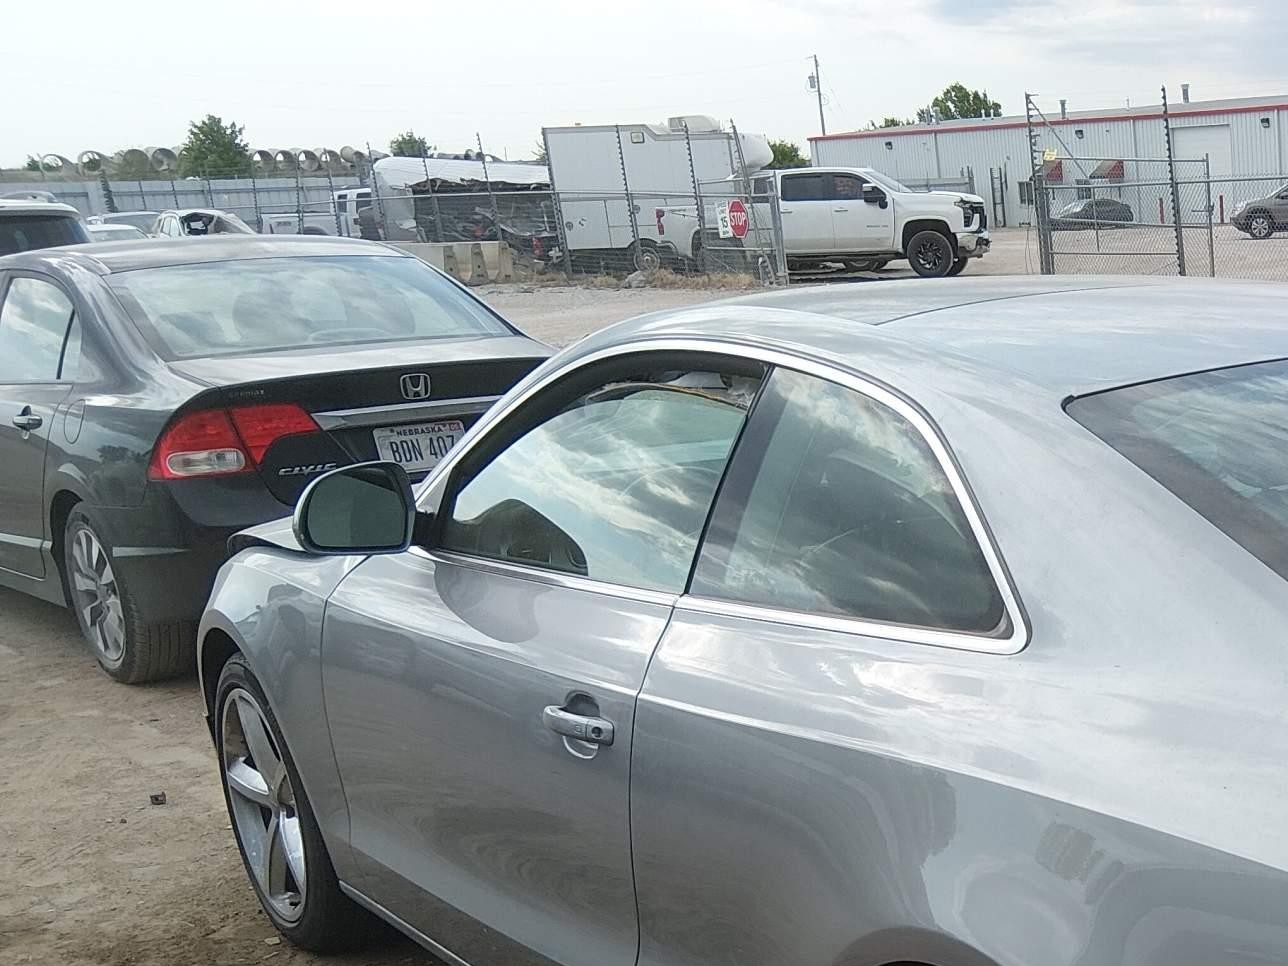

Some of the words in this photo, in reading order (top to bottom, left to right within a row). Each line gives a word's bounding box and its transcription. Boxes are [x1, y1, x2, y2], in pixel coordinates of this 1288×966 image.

[730, 211, 746, 227] STOP
[396, 425, 443, 438] NEBRASKA
[428, 434, 455, 461] 407
[278, 462, 337, 477] CIVIC
